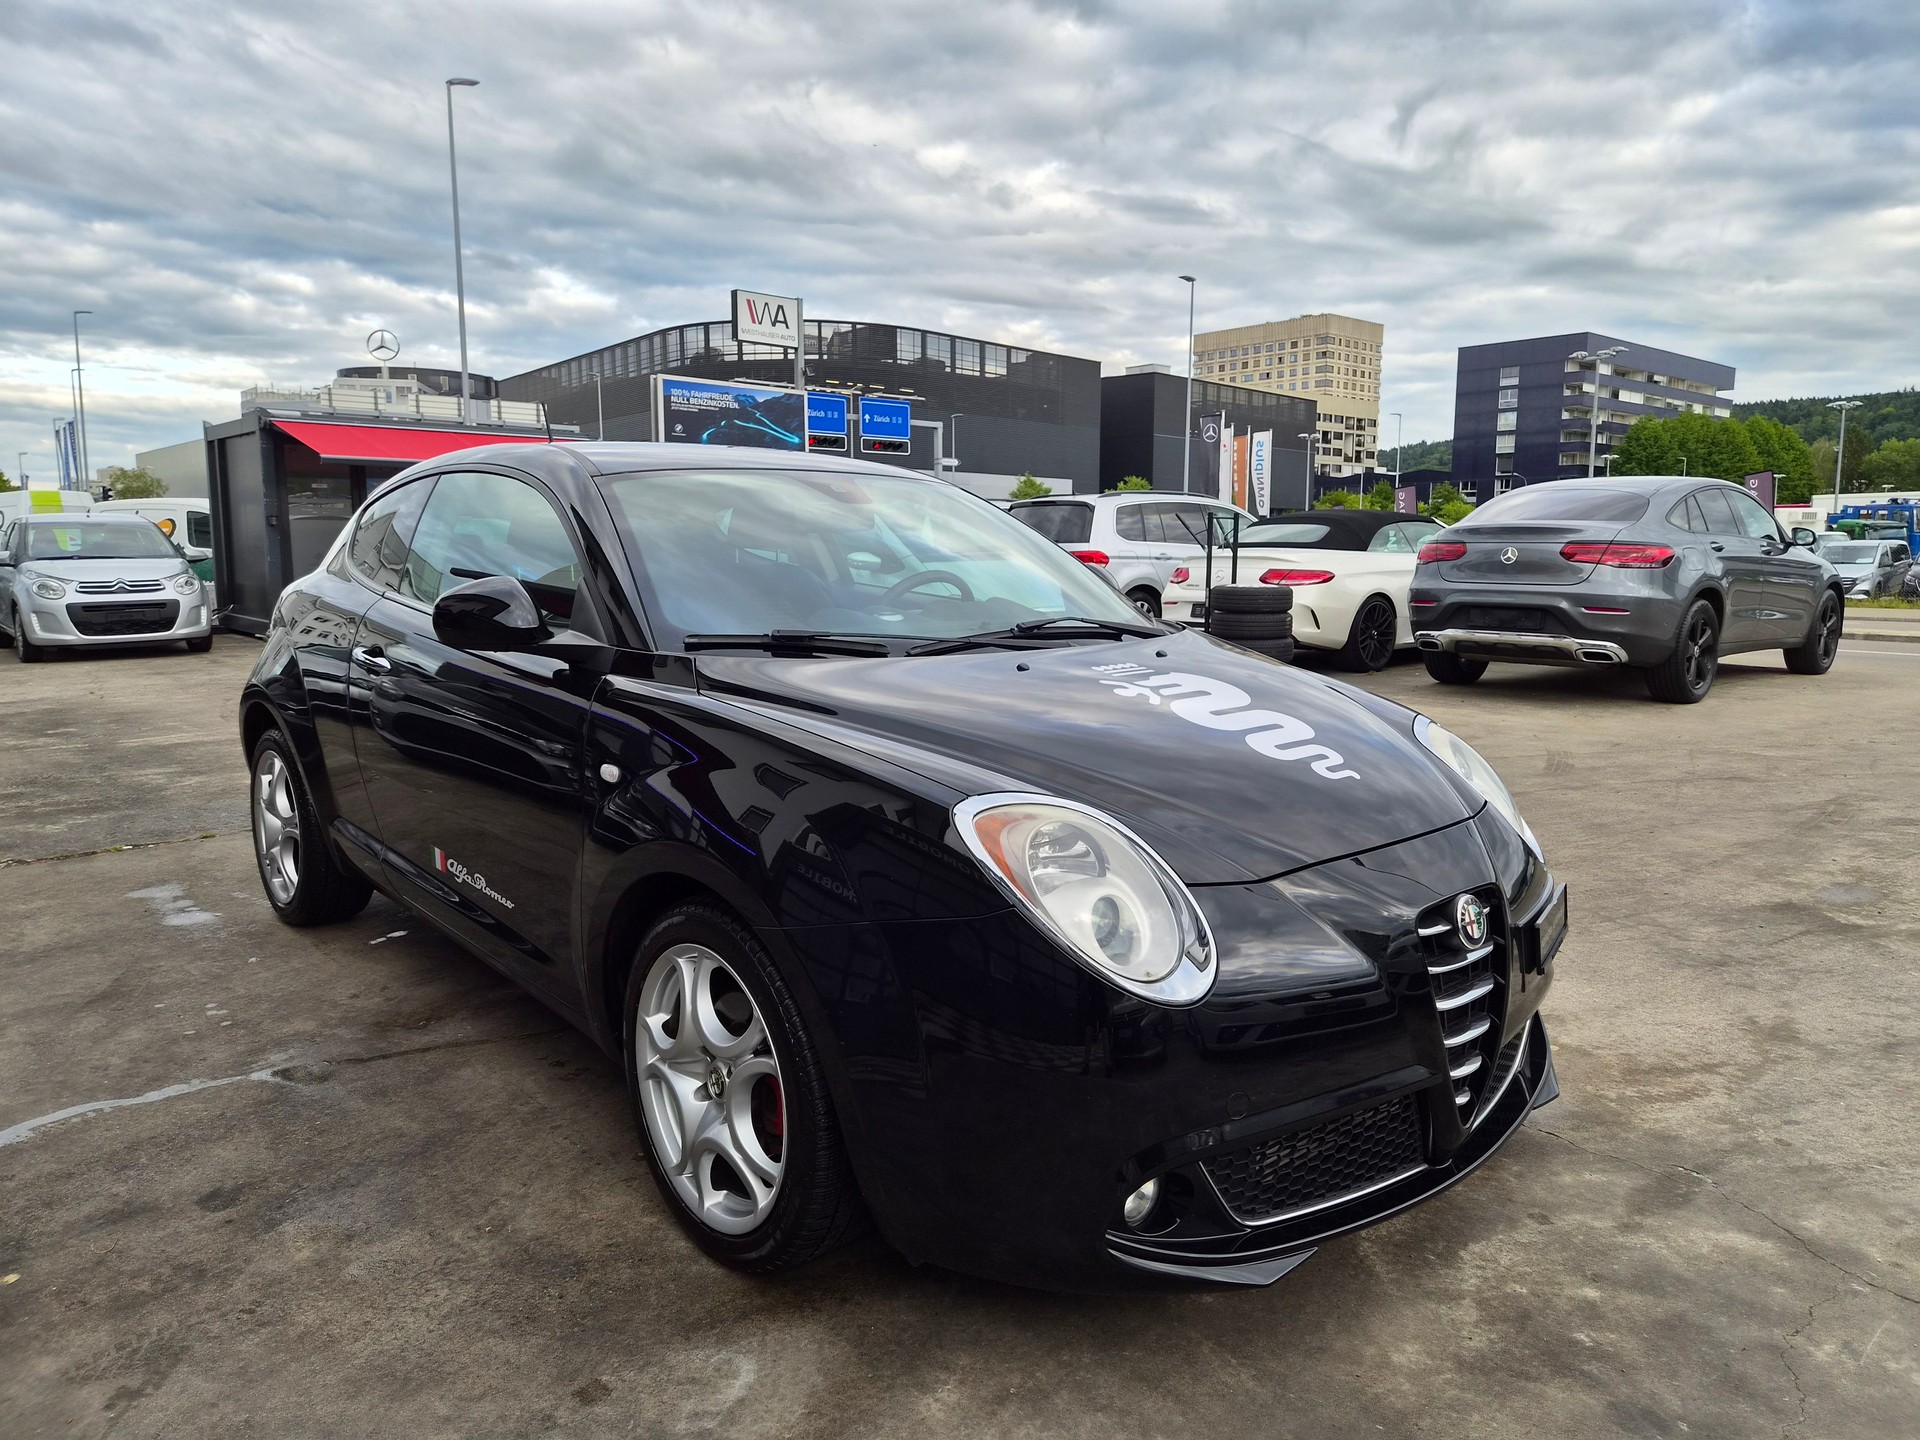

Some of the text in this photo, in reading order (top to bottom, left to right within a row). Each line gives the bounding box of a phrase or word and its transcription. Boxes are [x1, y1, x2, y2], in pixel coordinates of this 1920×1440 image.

[670, 388, 682, 396] 100
[691, 390, 735, 402] FAHRFREUDE.
[671, 395, 689, 404] NULL
[690, 397, 740, 409] BENZINKOSTEN.
[808, 409, 825, 418] Zürich
[873, 414, 890, 423] Zürich
[447, 858, 515, 909] Alfa Romeo
